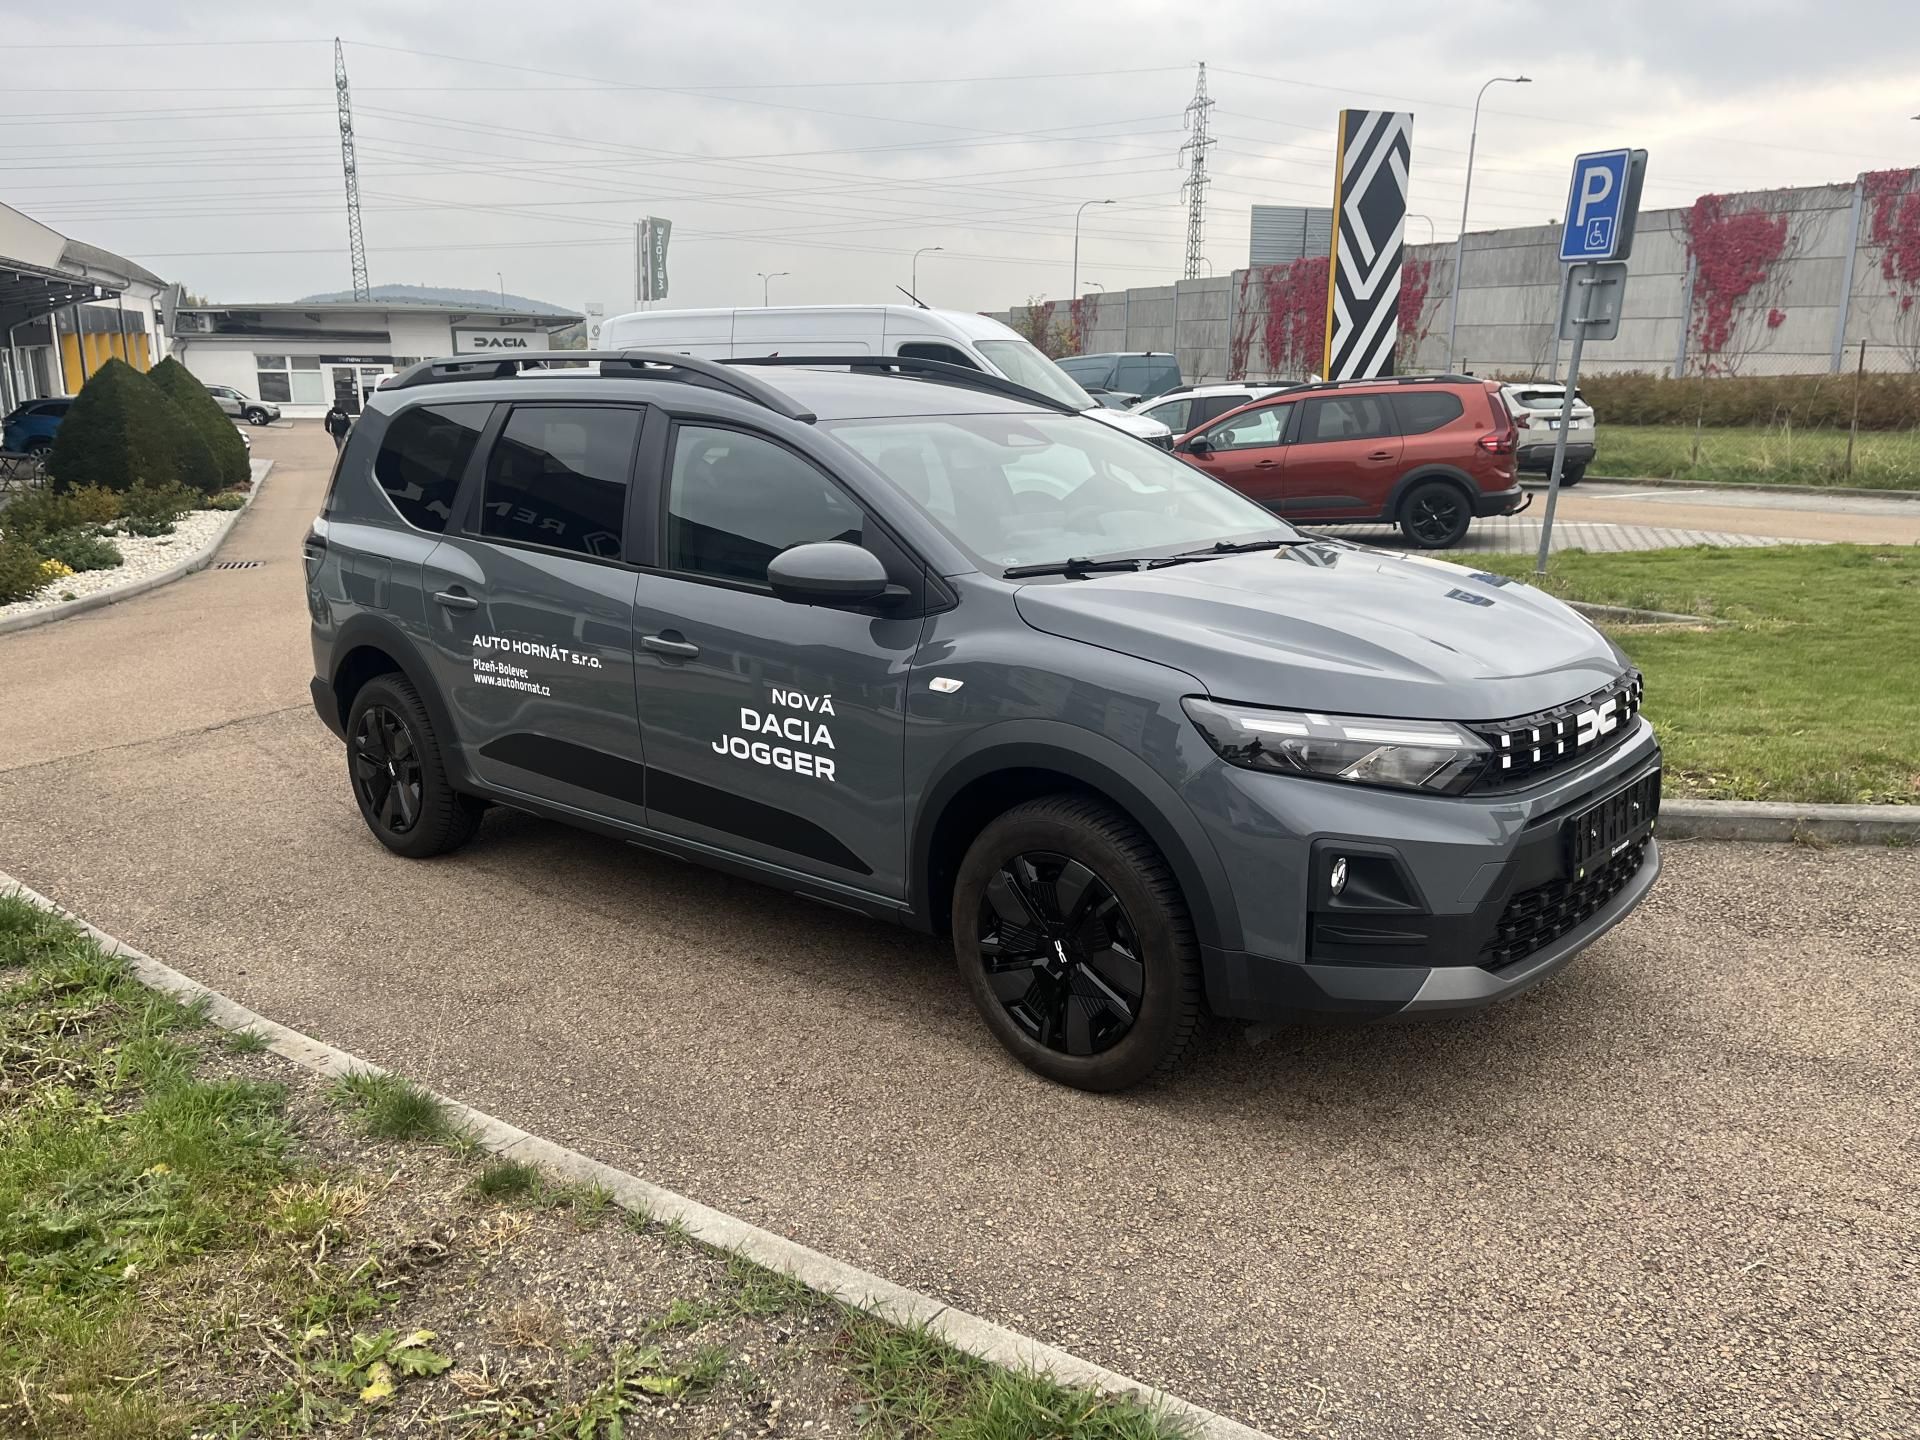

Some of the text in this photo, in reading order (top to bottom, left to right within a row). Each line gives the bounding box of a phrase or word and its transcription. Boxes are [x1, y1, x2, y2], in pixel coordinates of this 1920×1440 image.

[1576, 166, 1613, 227] P
[655, 227, 665, 290] WELCOME
[474, 337, 528, 348] DACIA
[472, 634, 602, 668] AUTO HORNÁT s.r.o.
[473, 658, 529, 679] Plzeň-Bolevec
[473, 672, 551, 697] www.autohornat.cz
[772, 688, 835, 716] NOVÁ
[740, 707, 836, 750] DACIA
[711, 734, 836, 782] JOGGER
